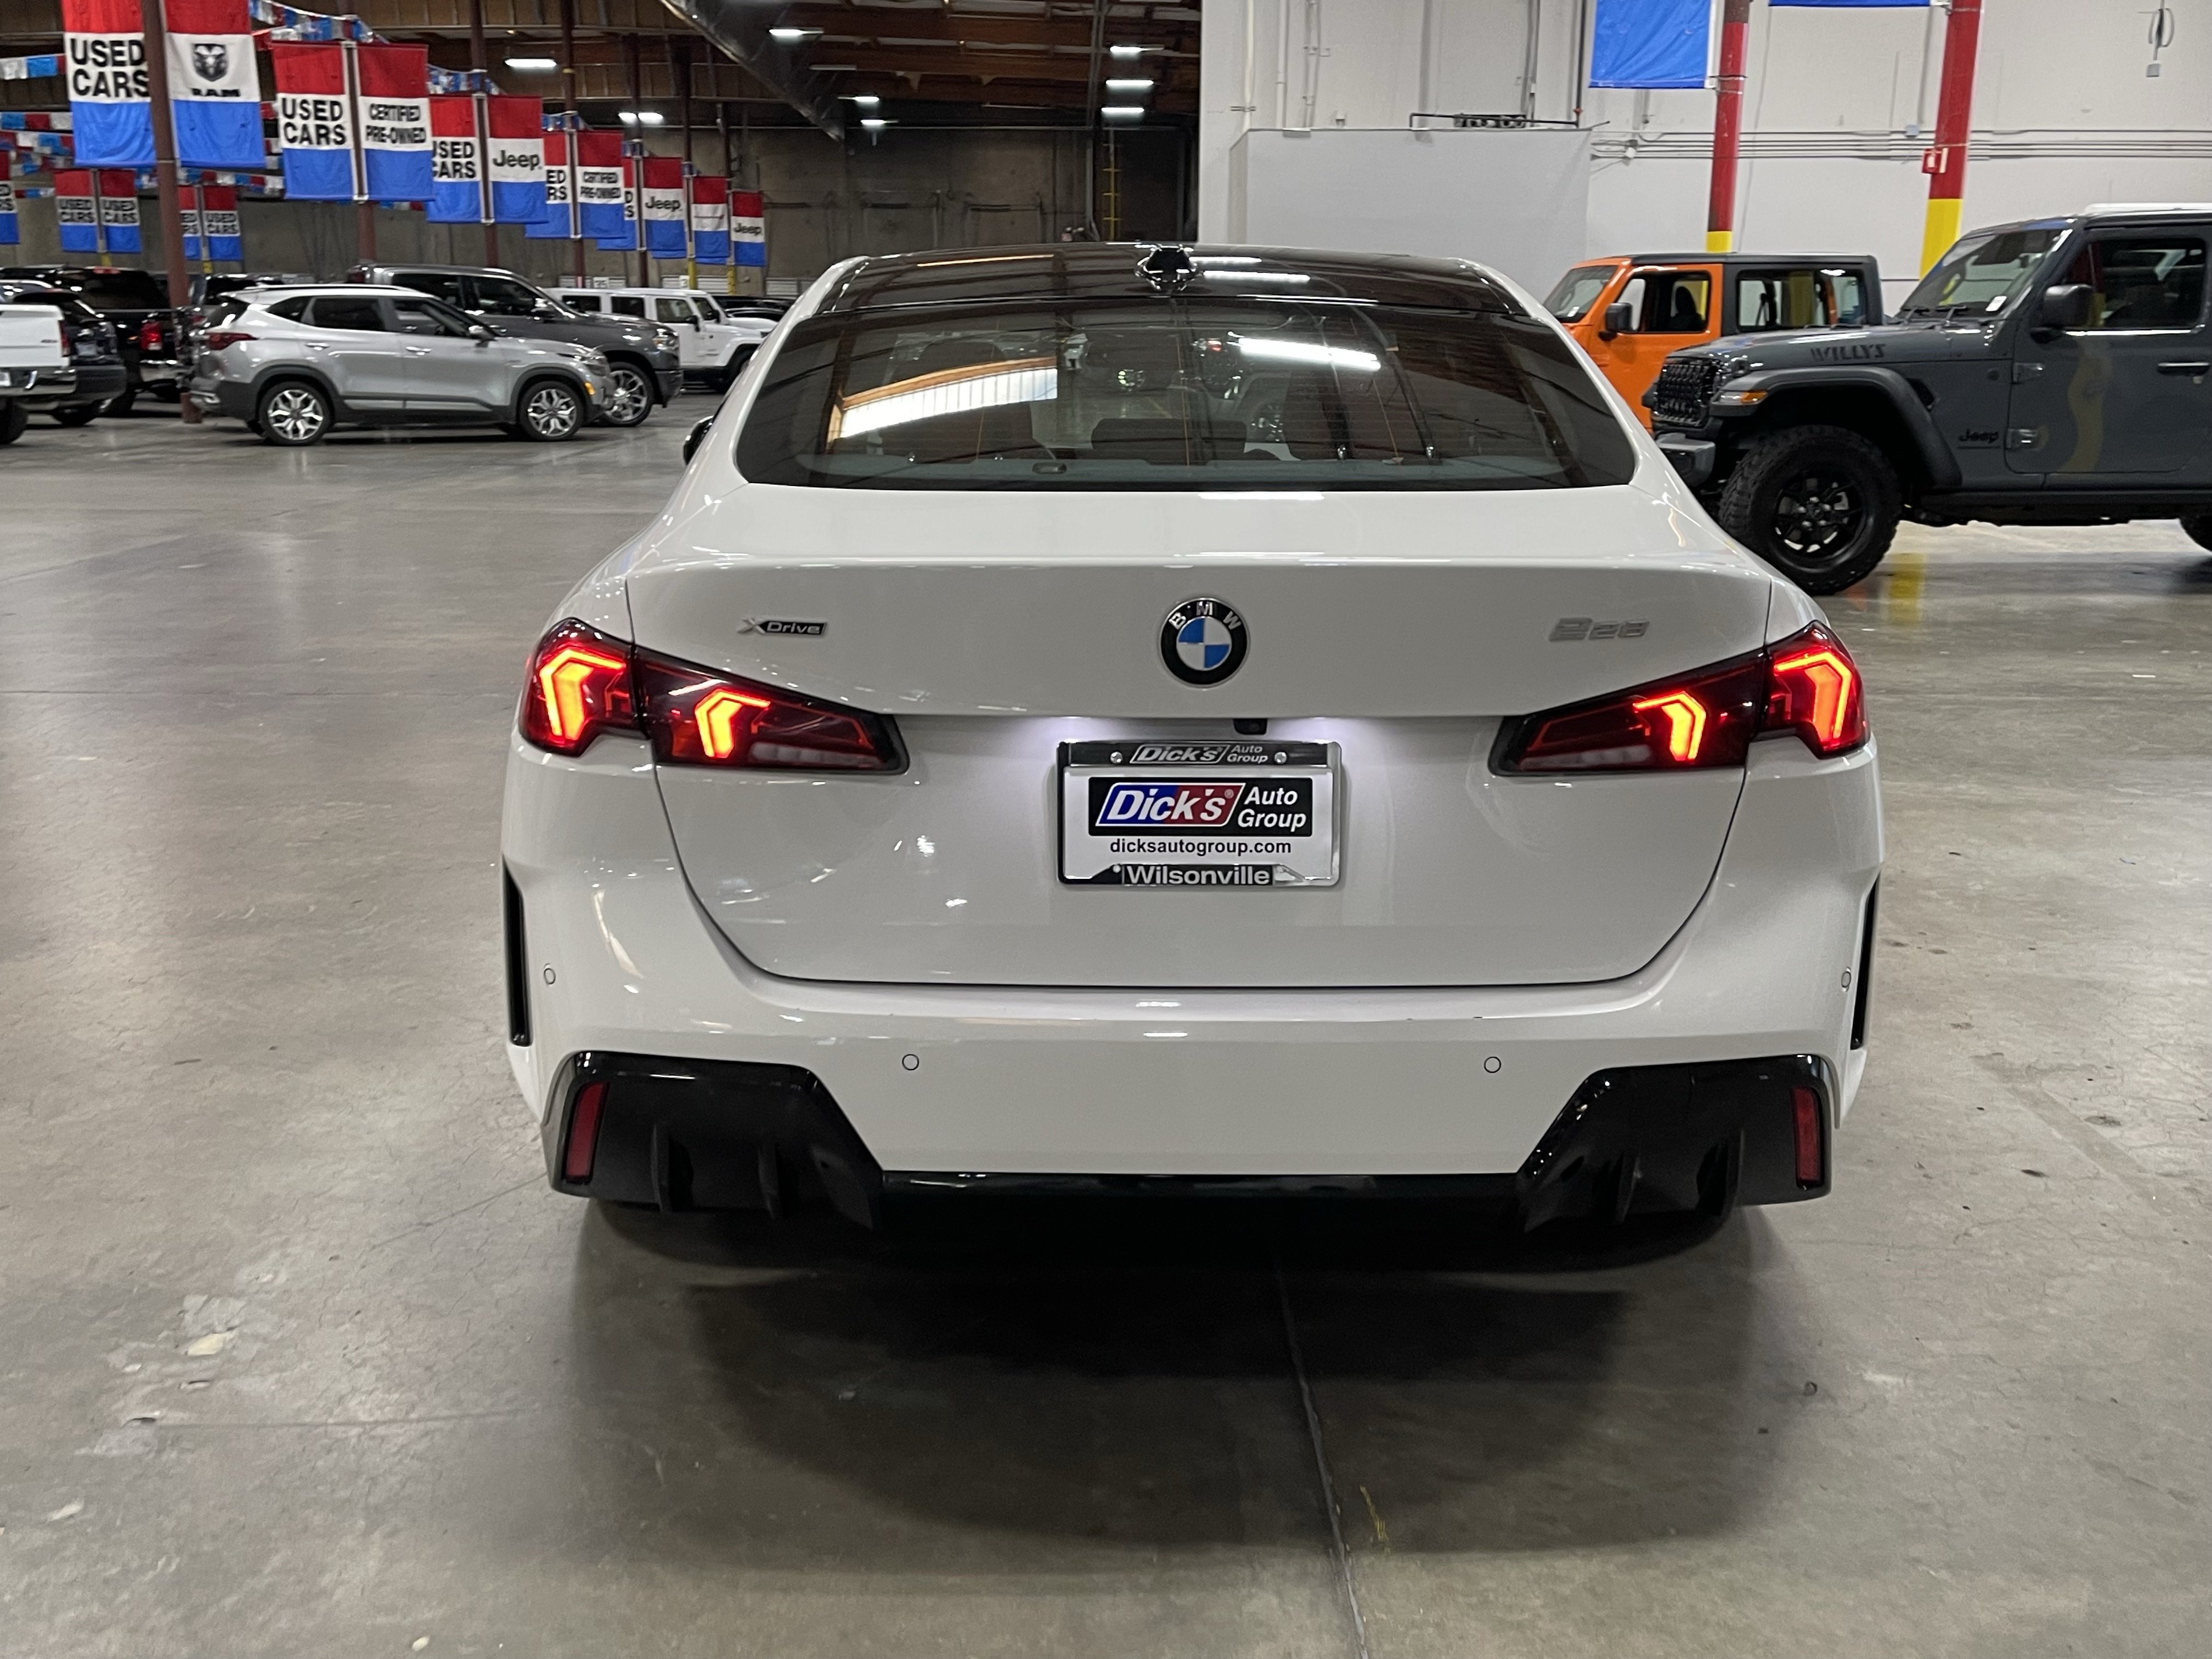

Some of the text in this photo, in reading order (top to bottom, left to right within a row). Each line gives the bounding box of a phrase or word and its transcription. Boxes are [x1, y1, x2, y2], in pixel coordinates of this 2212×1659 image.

[70, 38, 145, 66] USED
[73, 69, 149, 97] CARS
[191, 88, 240, 97] RAM
[281, 98, 343, 121] USED
[370, 103, 421, 121] CERTIFIED
[283, 122, 347, 145] CARS
[366, 125, 427, 144] PRE-OWNED
[493, 150, 540, 171] Jeep
[645, 196, 681, 212] Jeep
[733, 223, 761, 236] Jeep
[1811, 343, 1886, 361] WILLYS
[1959, 429, 1999, 444] Jeep
[1169, 601, 1242, 630] BMW
[1137, 747, 1218, 761] Dick's
[1227, 753, 1268, 764] Group
[1231, 745, 1263, 753] Auto
[1107, 788, 1226, 821] Dick's
[1244, 786, 1299, 806] Auto
[1238, 809, 1307, 832] Group
[1110, 838, 1291, 856] dicksautogroup.com
[1126, 865, 1270, 884] Wilsonville
